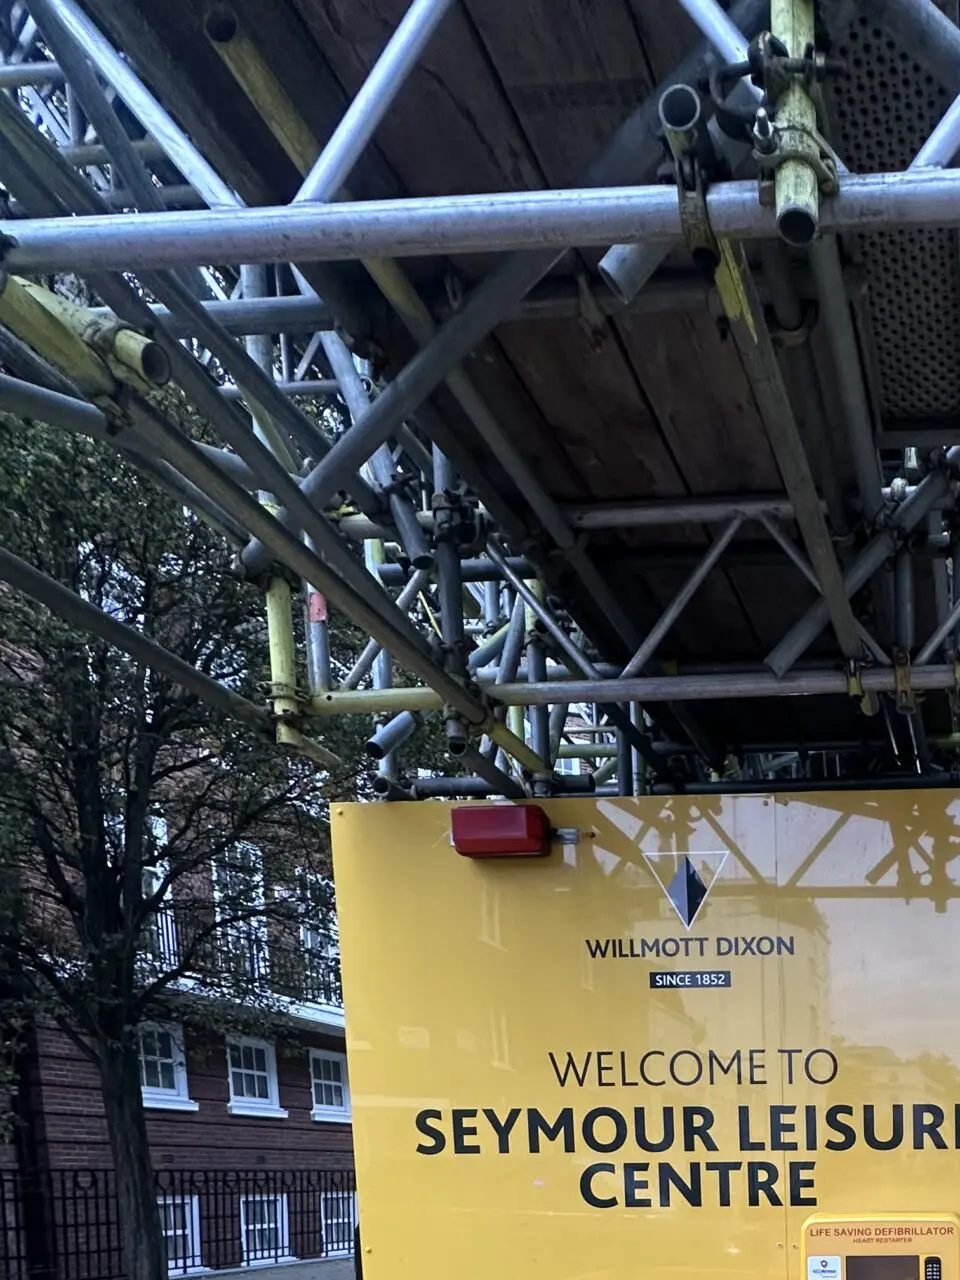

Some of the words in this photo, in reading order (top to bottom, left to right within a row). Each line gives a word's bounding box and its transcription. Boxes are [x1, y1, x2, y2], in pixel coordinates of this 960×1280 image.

[585, 937, 709, 959] WILLMOTT
[716, 936, 795, 957] DIXON
[655, 974, 692, 987] SINCE
[695, 973, 726, 986] 1852
[549, 1050, 768, 1088] WELCOME
[778, 1048, 839, 1086] TO
[415, 1106, 717, 1156] SEYMOUR
[579, 1161, 818, 1209] CENTRE
[810, 1229, 831, 1237] LIFE
[832, 1228, 872, 1236] SAVING
[874, 1227, 954, 1236] DEFIBRILLATOR
